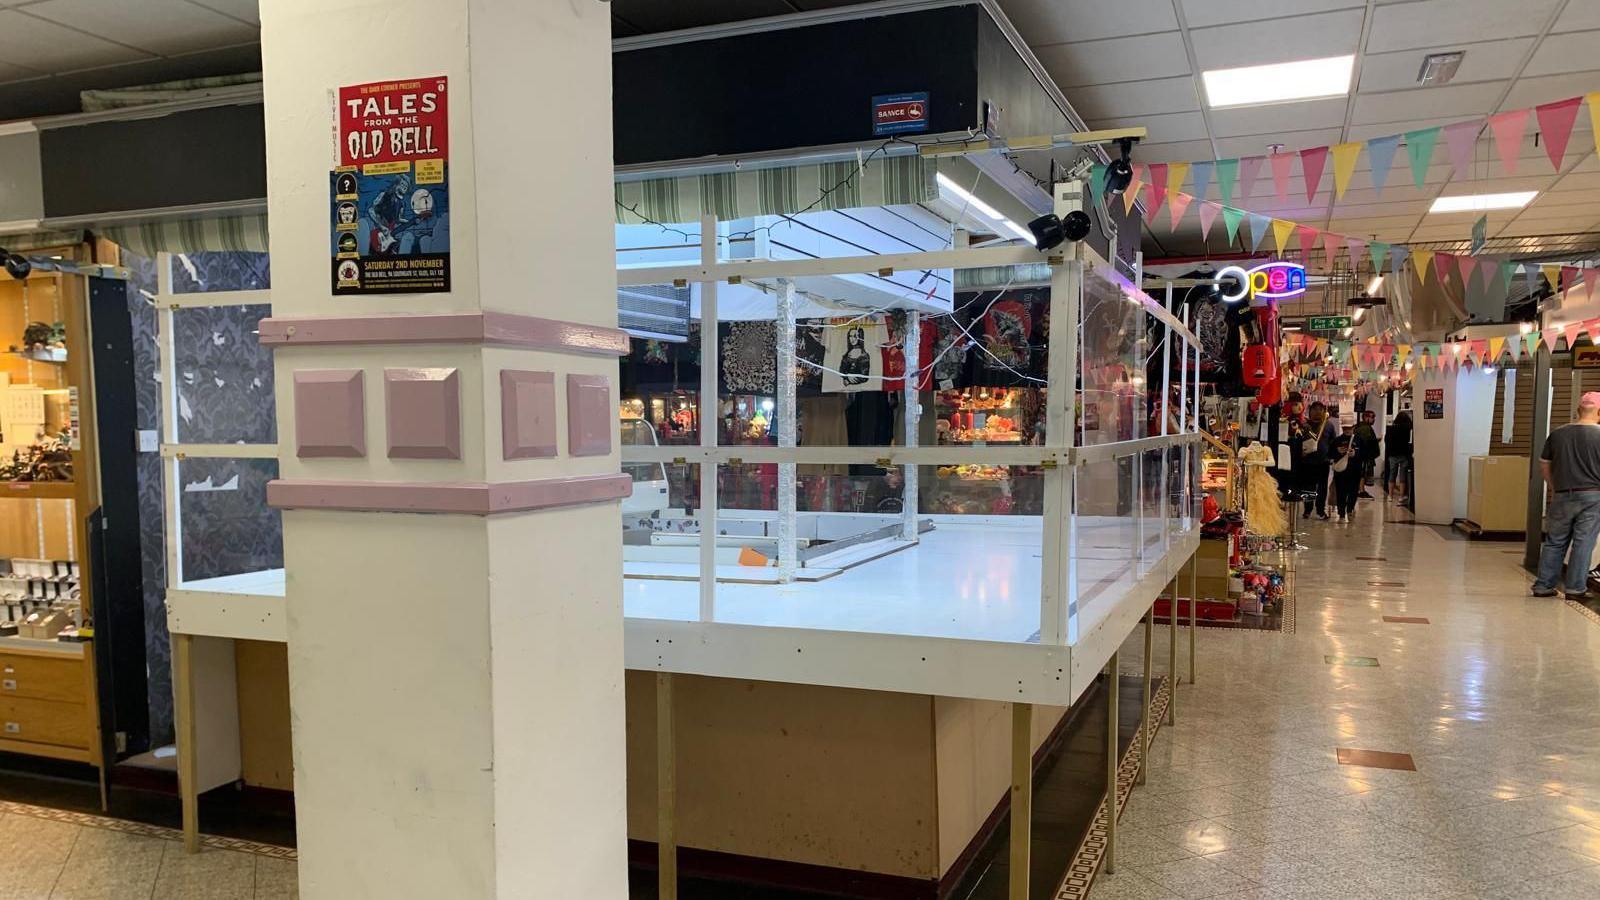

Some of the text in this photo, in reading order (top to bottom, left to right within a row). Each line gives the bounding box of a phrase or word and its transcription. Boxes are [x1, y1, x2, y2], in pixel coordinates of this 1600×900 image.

[347, 93, 437, 118] TALES
[364, 116, 418, 127] FROM THE
[348, 126, 438, 160] OLD BELL
[364, 259, 444, 270] SATURDAY 2ND NOVEMBER
[1213, 265, 1306, 301] Open
